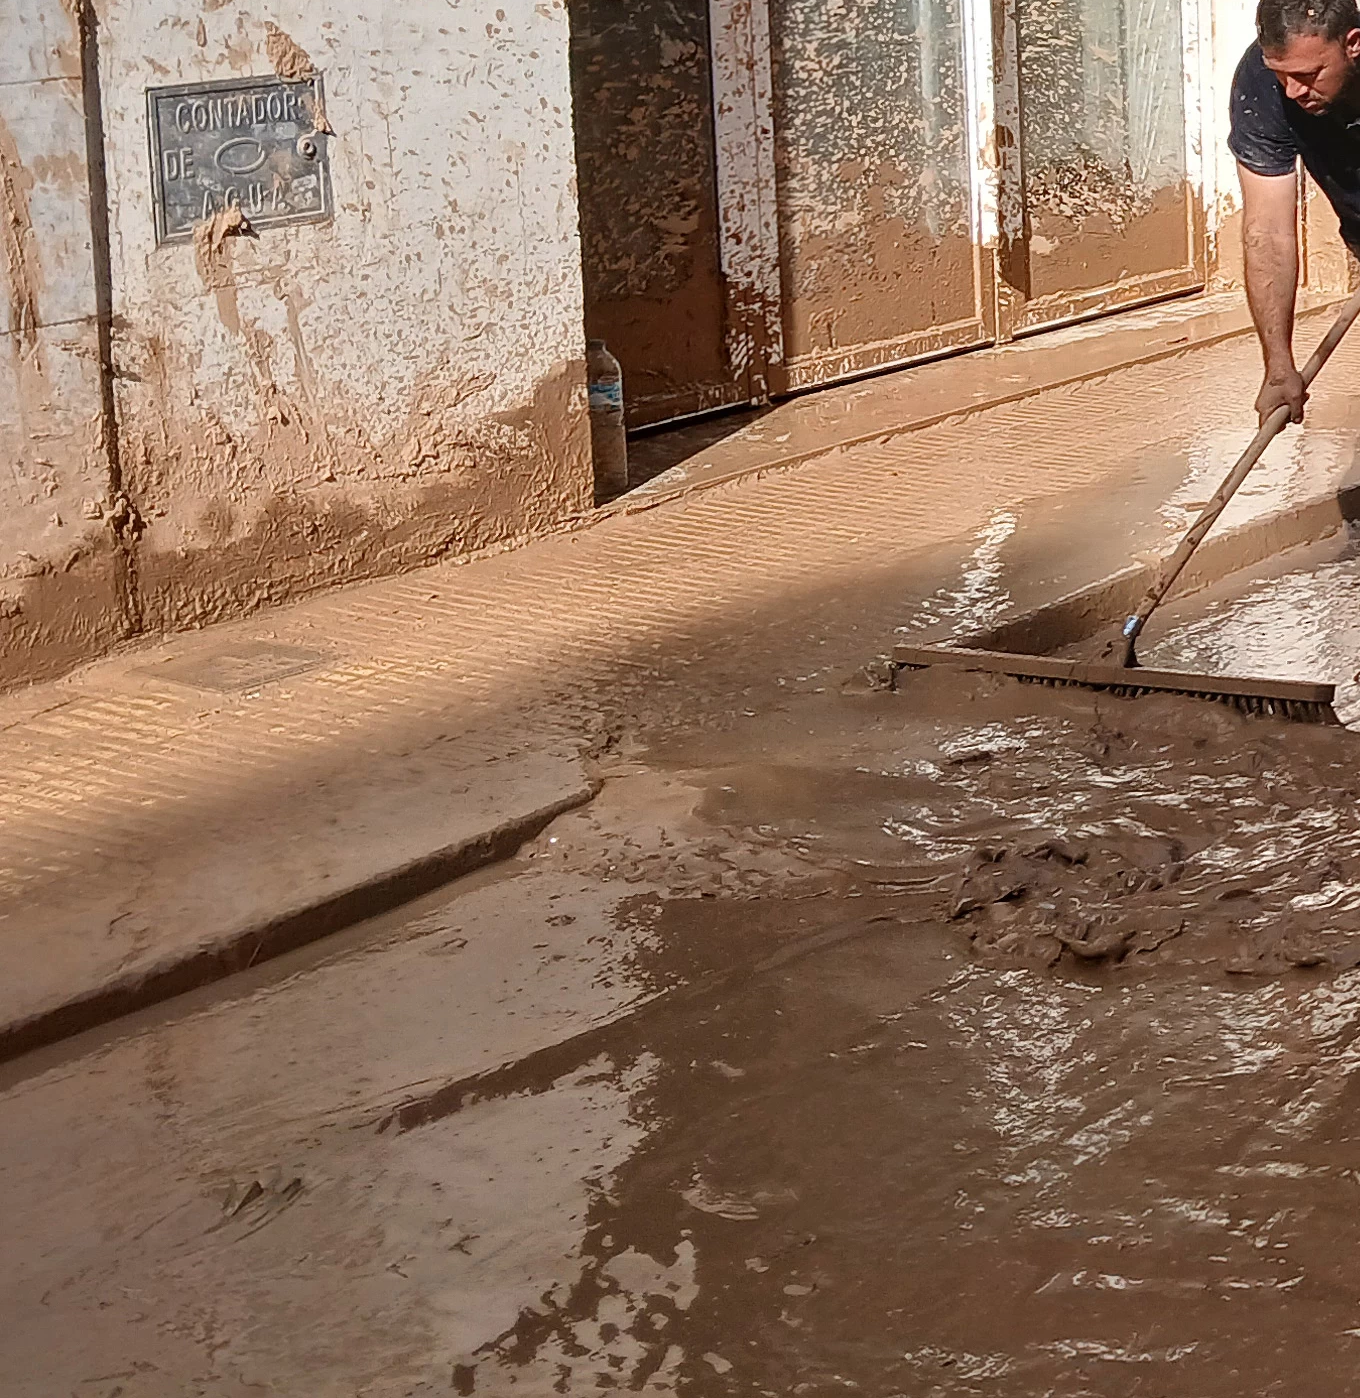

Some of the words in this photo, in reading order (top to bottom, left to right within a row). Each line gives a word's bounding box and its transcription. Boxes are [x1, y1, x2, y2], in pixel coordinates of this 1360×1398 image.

[175, 91, 302, 134] CONTADOR
[163, 147, 196, 182] DE
[201, 181, 291, 221] AGUA
